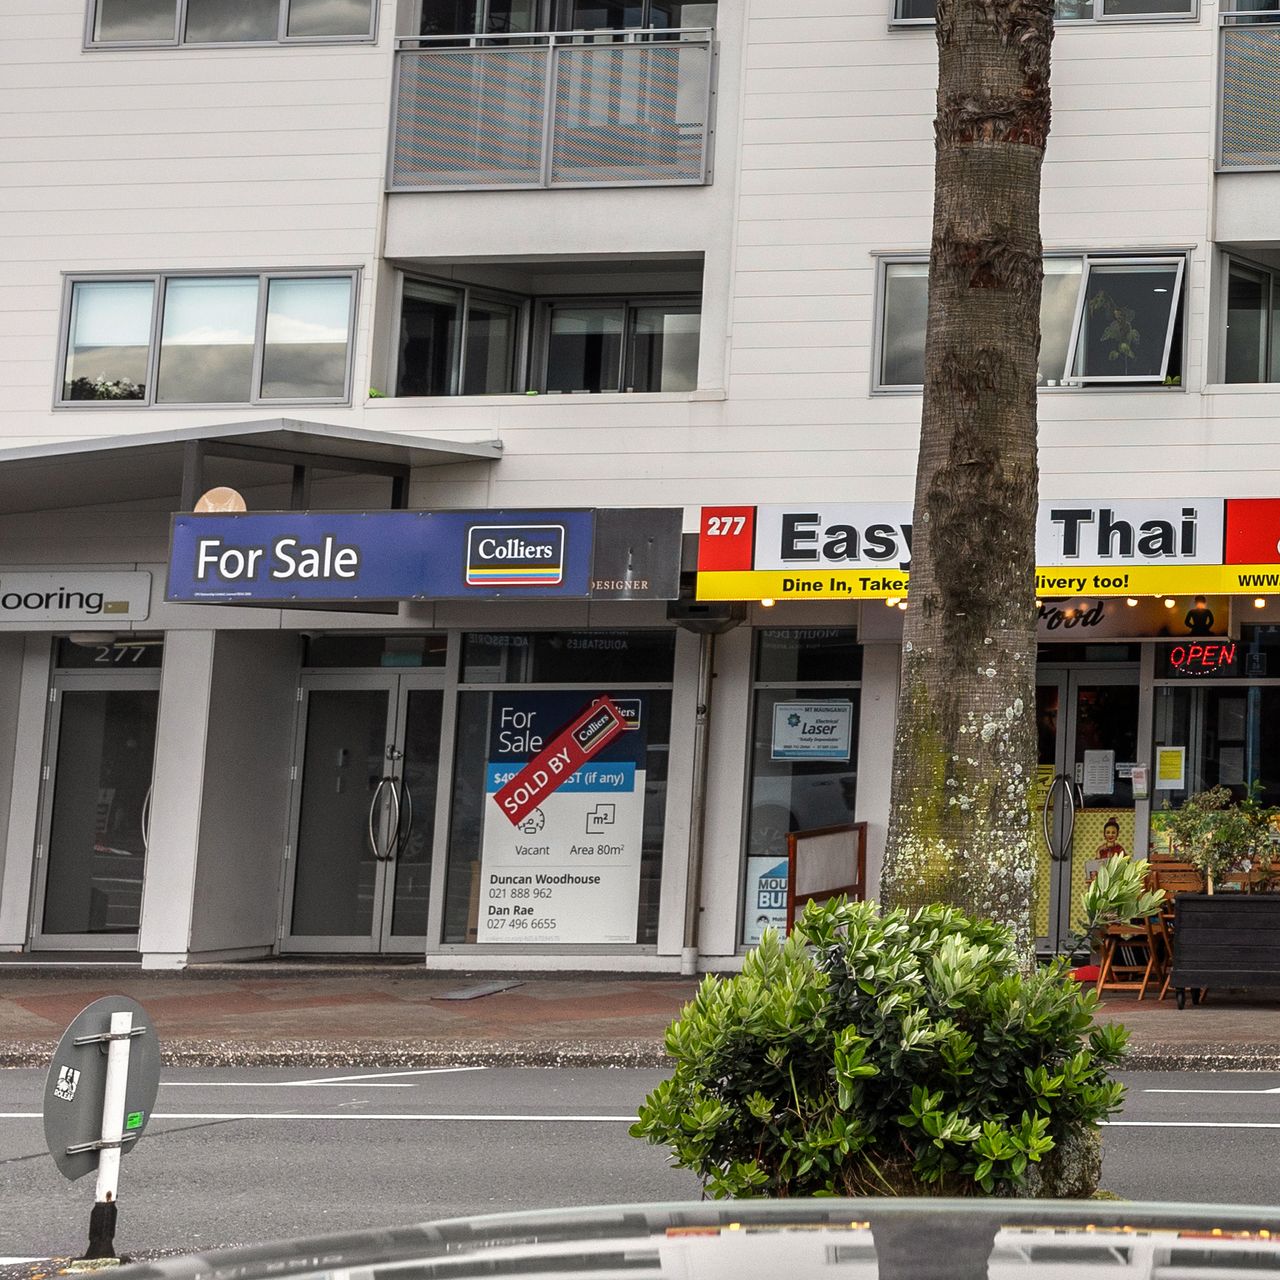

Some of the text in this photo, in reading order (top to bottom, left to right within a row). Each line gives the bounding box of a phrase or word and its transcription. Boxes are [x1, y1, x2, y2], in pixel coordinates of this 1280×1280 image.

[707, 517, 746, 536] 277
[1050, 508, 1197, 558] Thai
[479, 538, 553, 560] Colliers
[197, 537, 358, 579] For Sale
[783, 578, 823, 592] Dine
[830, 578, 852, 593] In,
[1036, 575, 1087, 591] livery
[1093, 575, 1128, 587] too!
[0, 586, 104, 614] ooring
[94, 646, 145, 662] 277
[1171, 645, 1235, 666] OPEN
[501, 707, 536, 728] For
[579, 714, 609, 741] Colliers
[801, 722, 837, 735] Laser
[499, 730, 543, 753] Sale
[504, 747, 572, 814] SOLD BY
[564, 772, 582, 783] ST
[585, 772, 598, 785] (if
[600, 772, 624, 786] any)
[515, 845, 550, 856] Vacant
[570, 845, 594, 855] Area
[490, 874, 601, 885] Duncan Woodhouse
[758, 880, 787, 889] MOU
[489, 888, 552, 898] 021 888 962
[760, 892, 787, 907] BUI
[488, 905, 534, 915] Dan Rae
[487, 919, 557, 929] 027 496 6655
